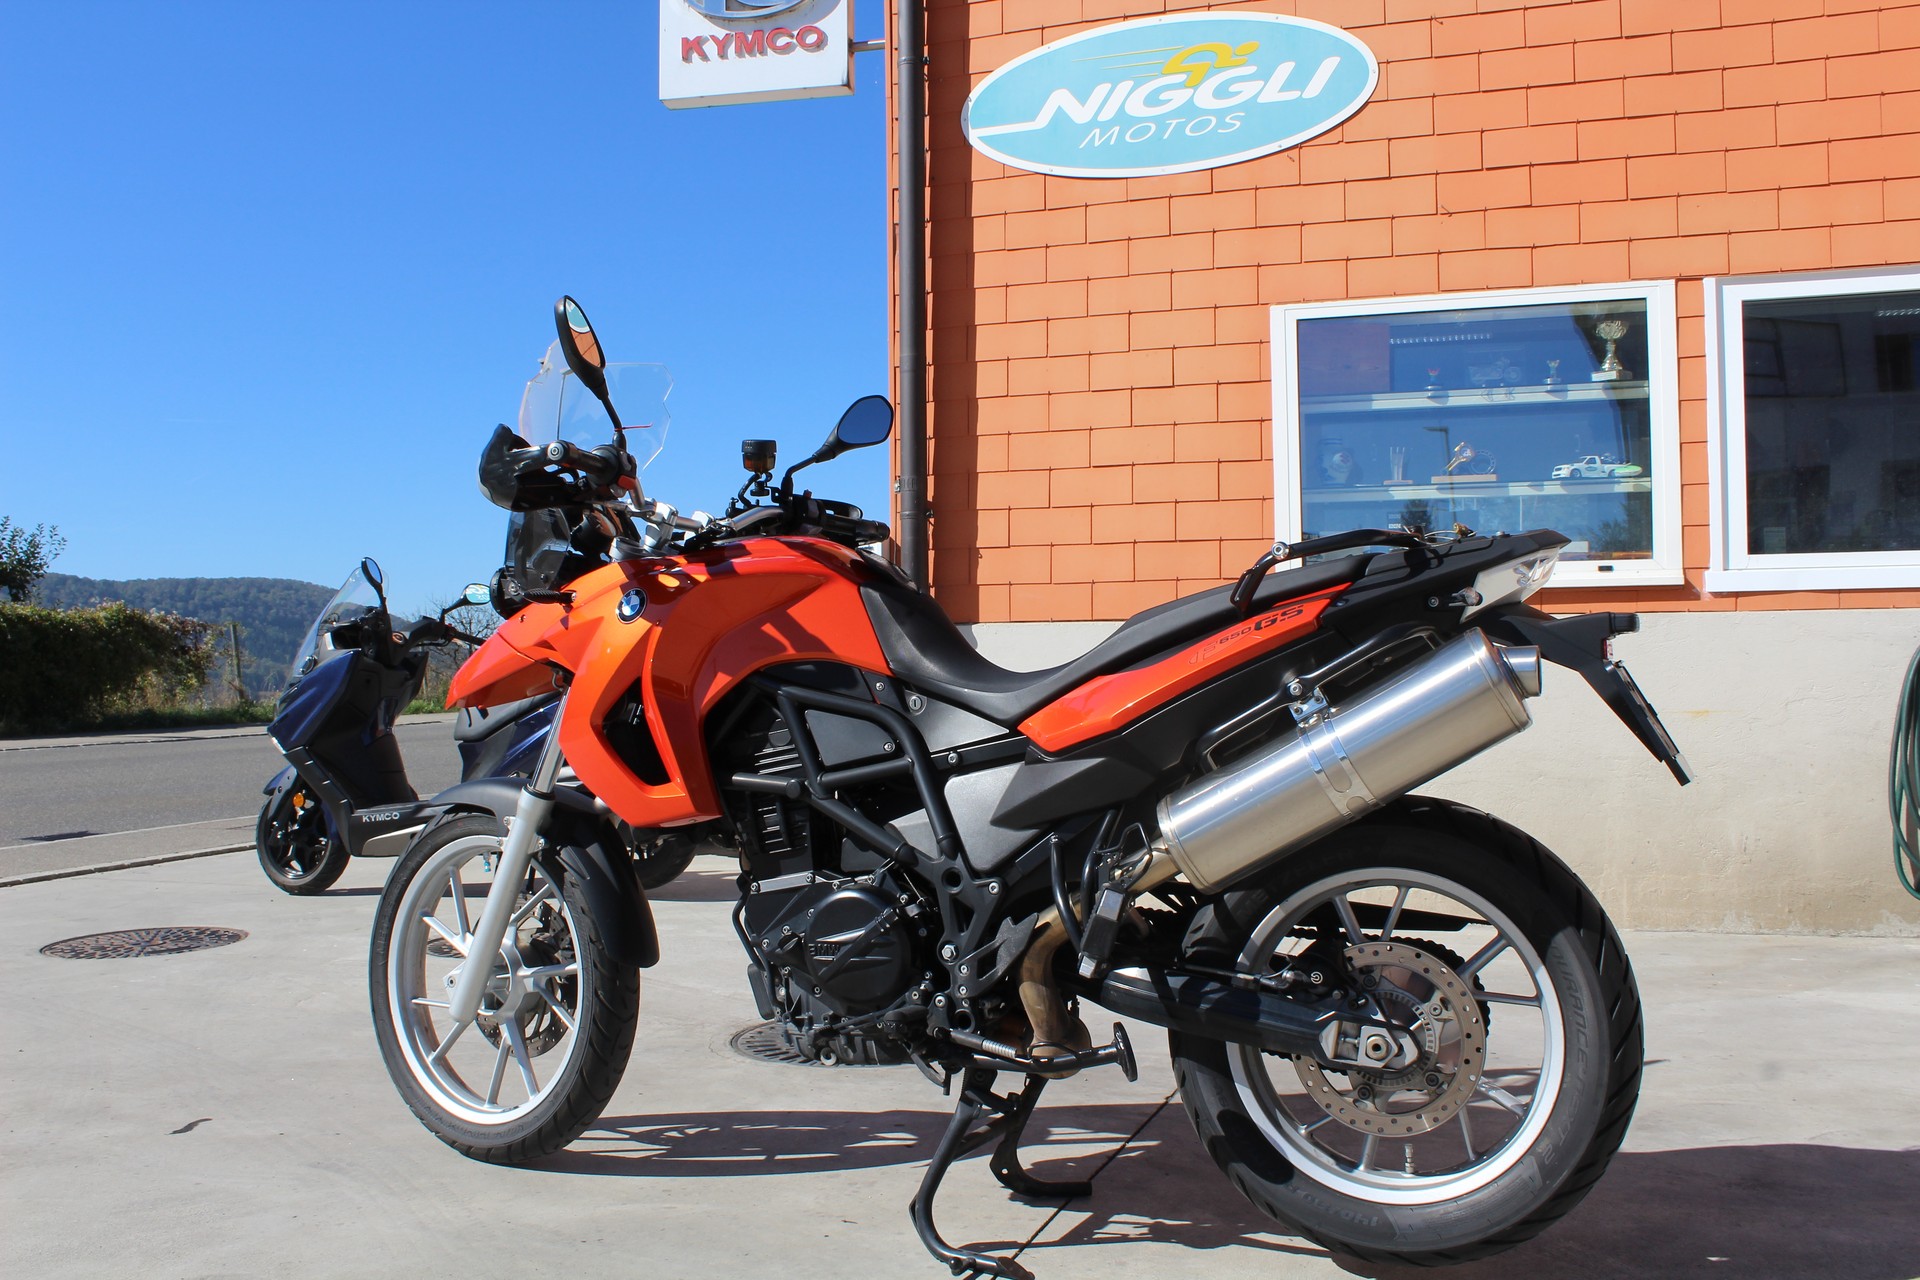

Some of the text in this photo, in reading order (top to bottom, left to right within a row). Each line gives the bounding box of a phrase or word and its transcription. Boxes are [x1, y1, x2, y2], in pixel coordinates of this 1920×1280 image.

[681, 25, 828, 63] KYMCO
[1030, 55, 1342, 129] NIGGLI
[1079, 112, 1245, 149] MOTOS
[362, 811, 400, 823] KYMCO
